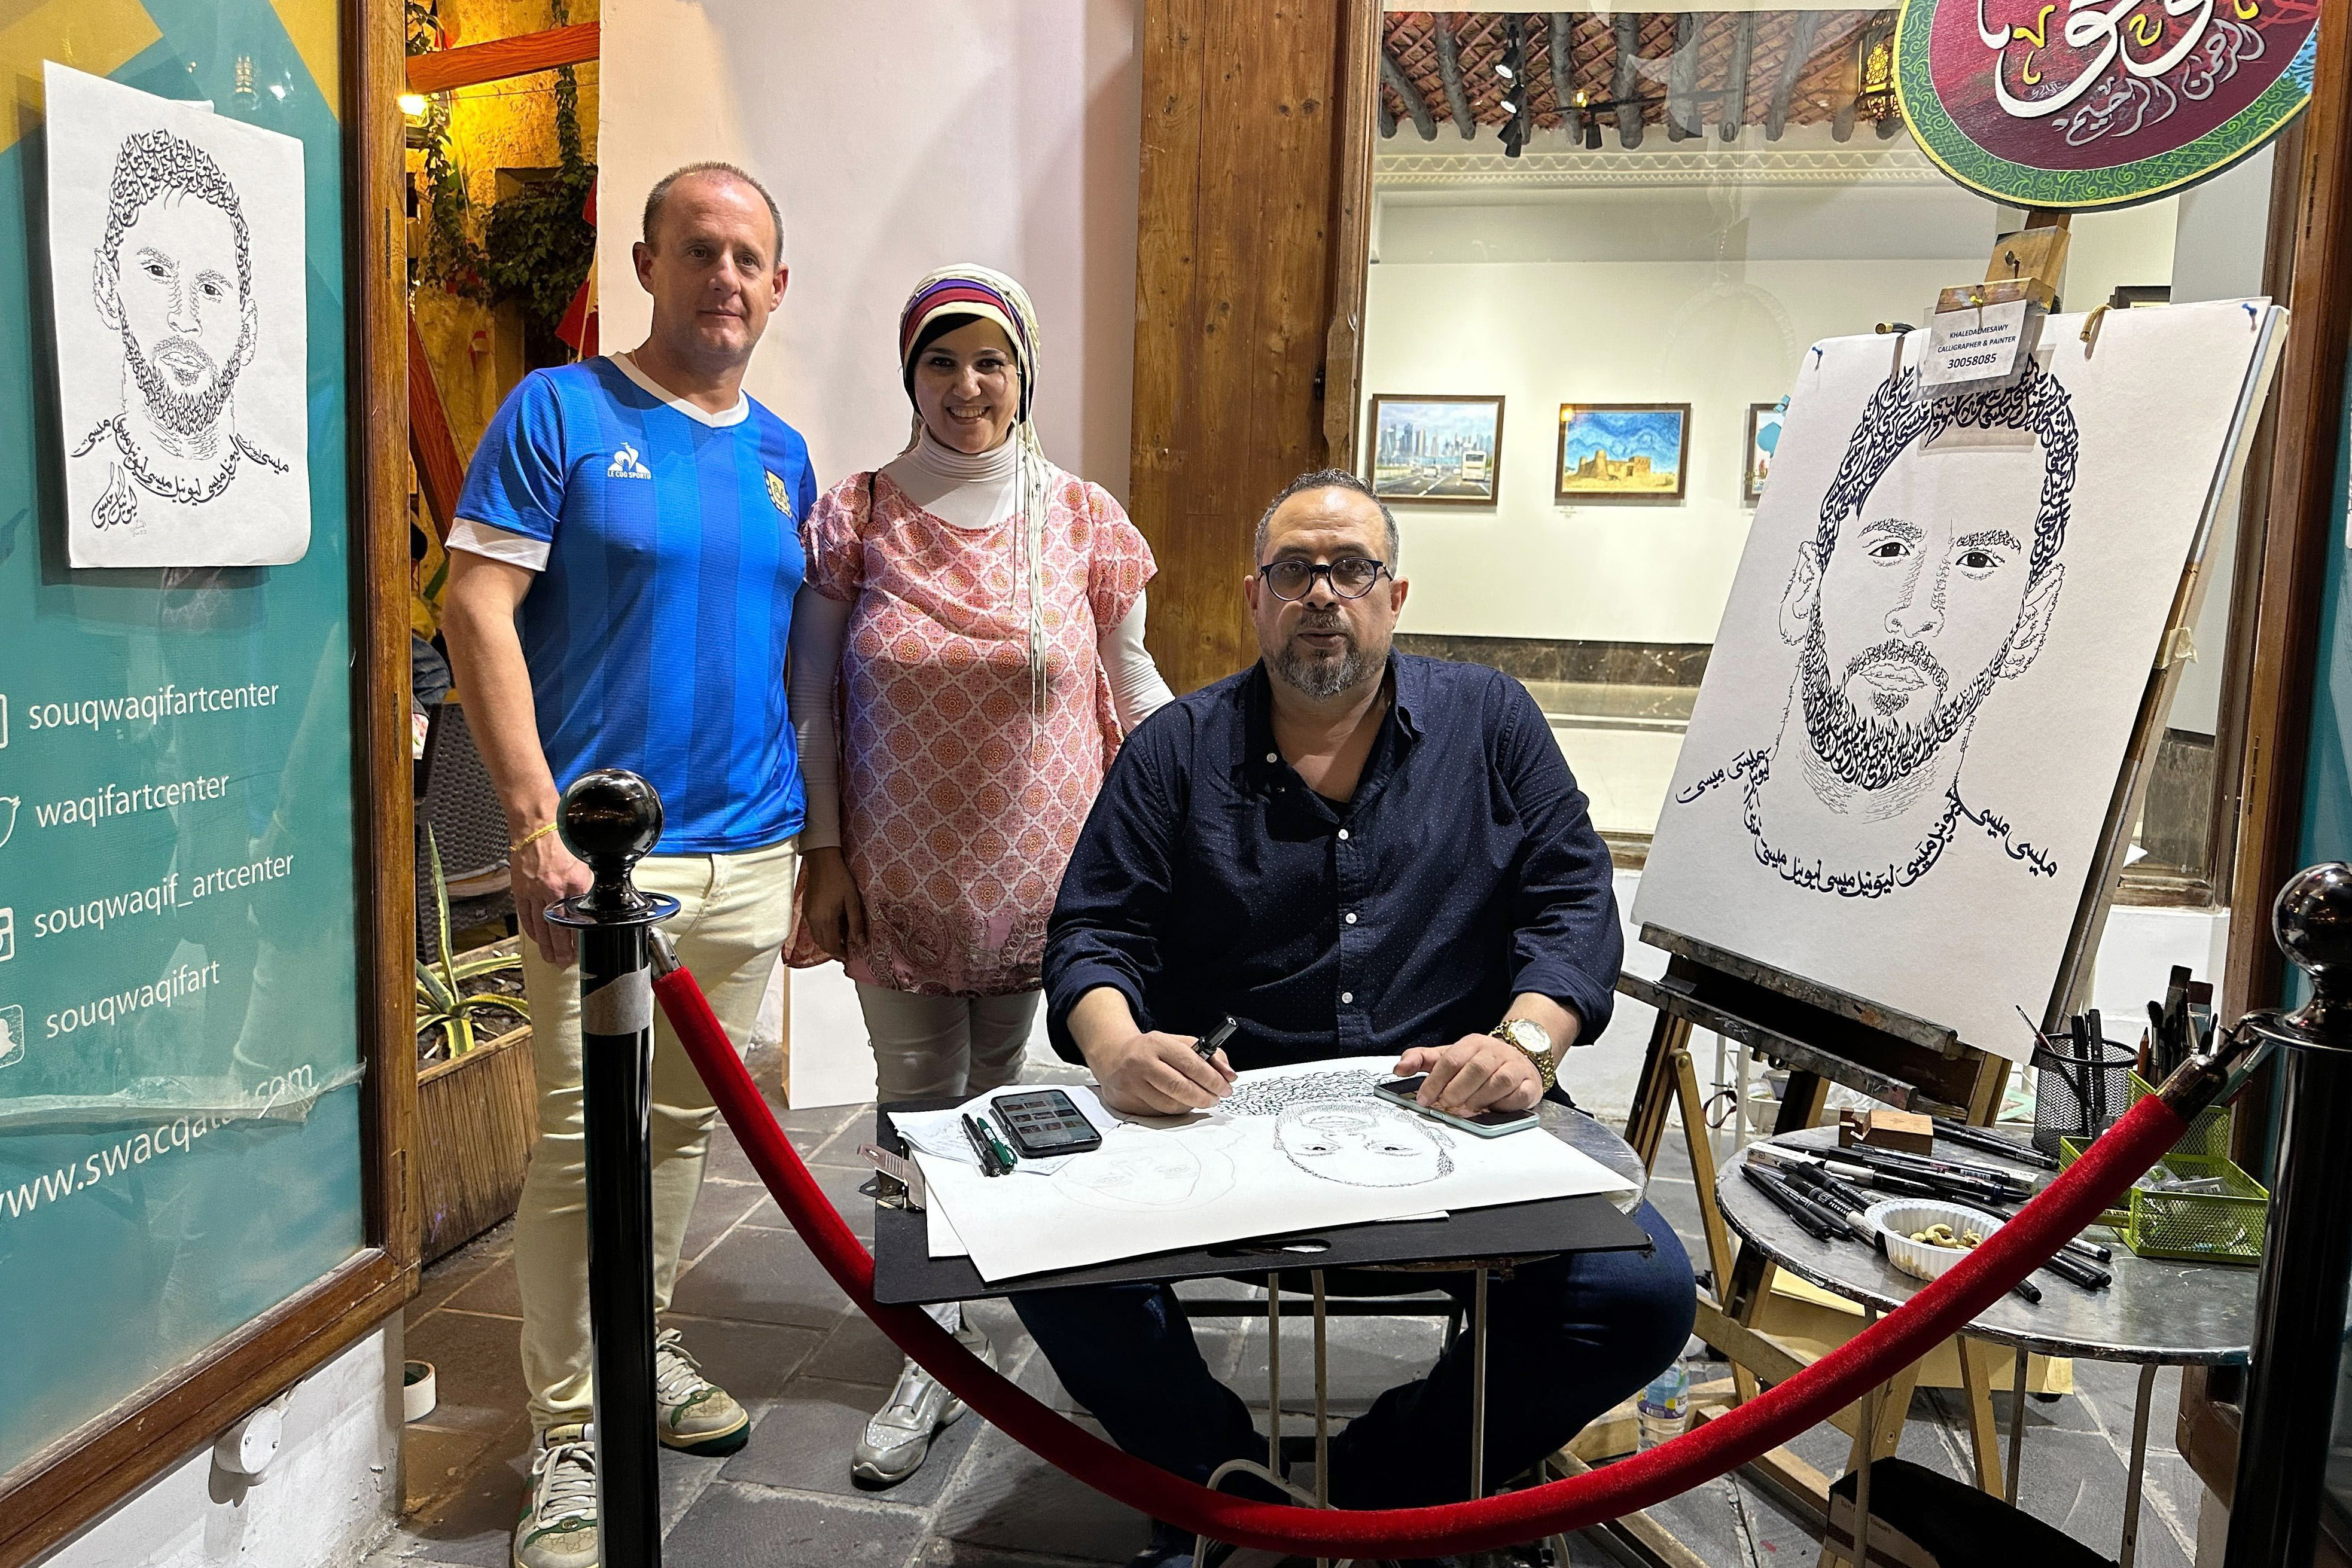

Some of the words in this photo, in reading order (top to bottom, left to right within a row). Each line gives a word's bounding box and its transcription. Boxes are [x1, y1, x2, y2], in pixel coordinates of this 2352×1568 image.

[1937, 341, 1982, 353] CALLIGRAPHER
[1989, 336, 2016, 346] PAINTER
[1947, 353, 1997, 369] 30058085
[29, 683, 279, 731] souqwaqifartcenter
[36, 775, 230, 828] waqifartcenter
[35, 854, 294, 938] souqwaqif_artcenter
[46, 960, 220, 1039] souqwaqifart
